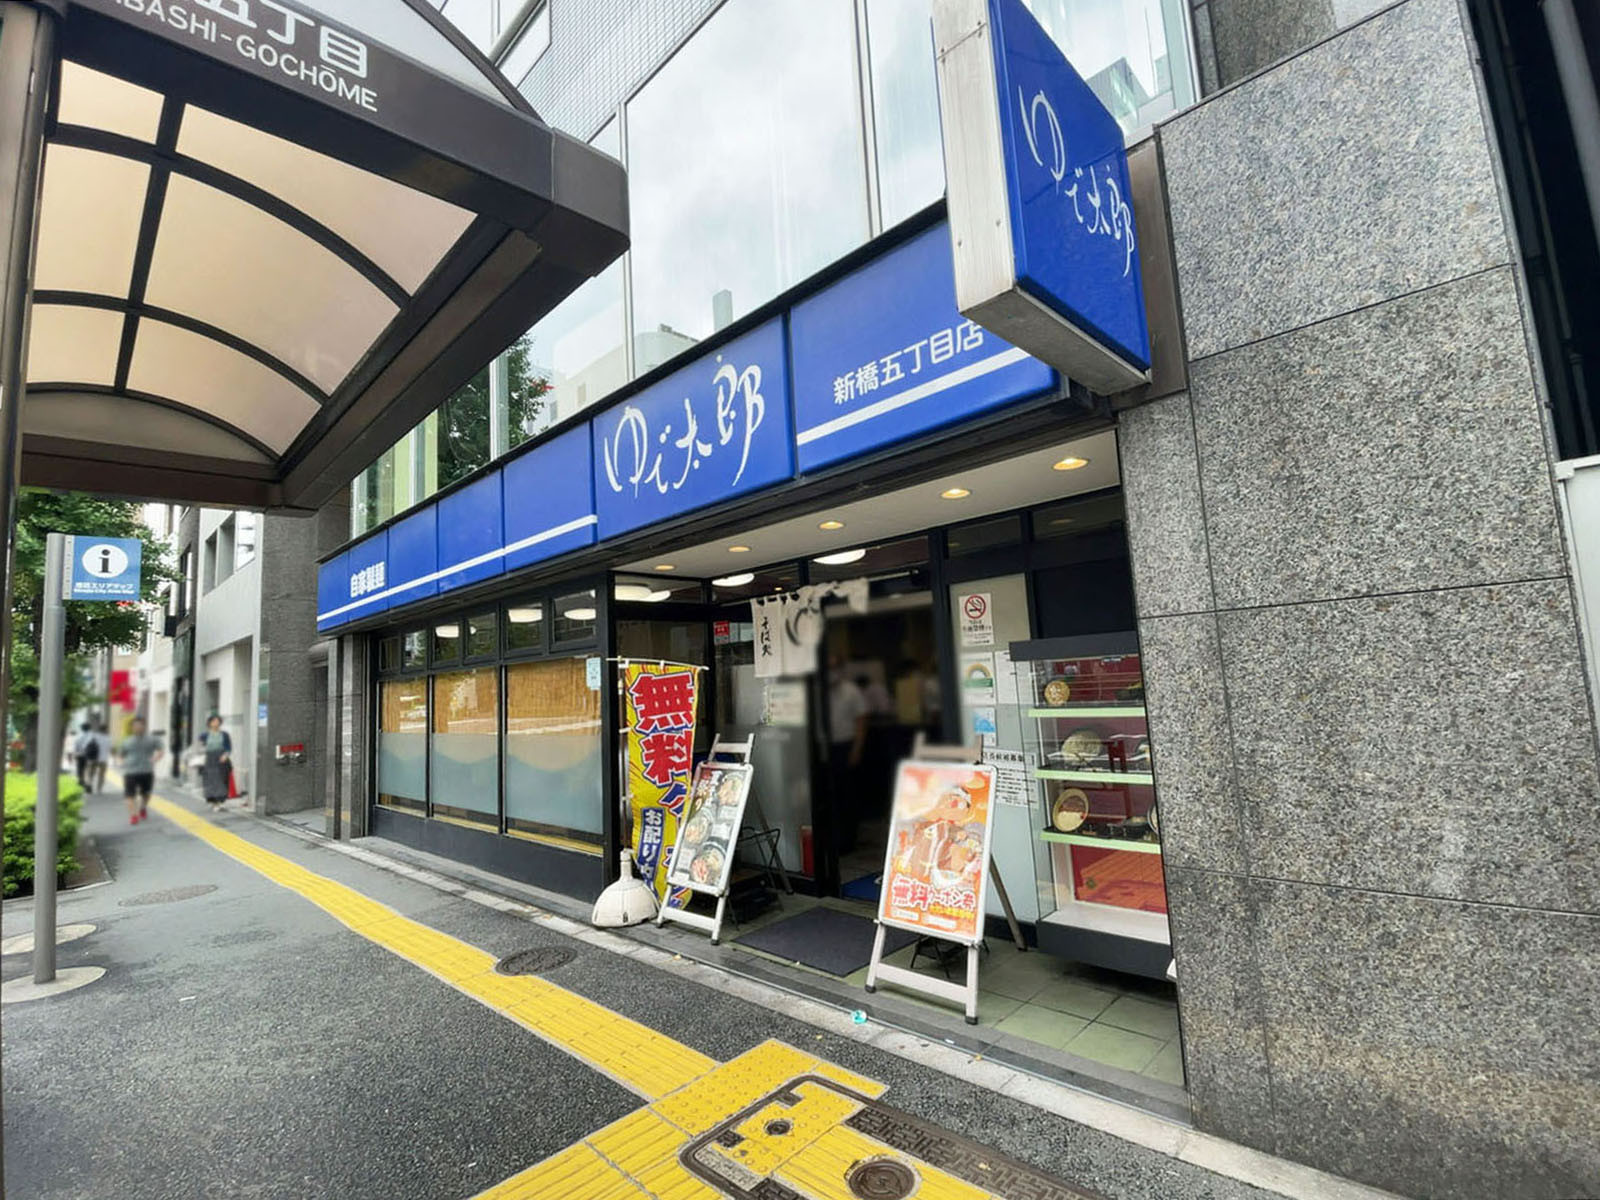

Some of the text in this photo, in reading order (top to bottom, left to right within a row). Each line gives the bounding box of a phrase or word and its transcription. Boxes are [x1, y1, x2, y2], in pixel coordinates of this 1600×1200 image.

[1018, 84, 1135, 278] ゆで太郎
[604, 354, 765, 499] ゆで太郎
[833, 319, 984, 405] 新橋五丁目店
